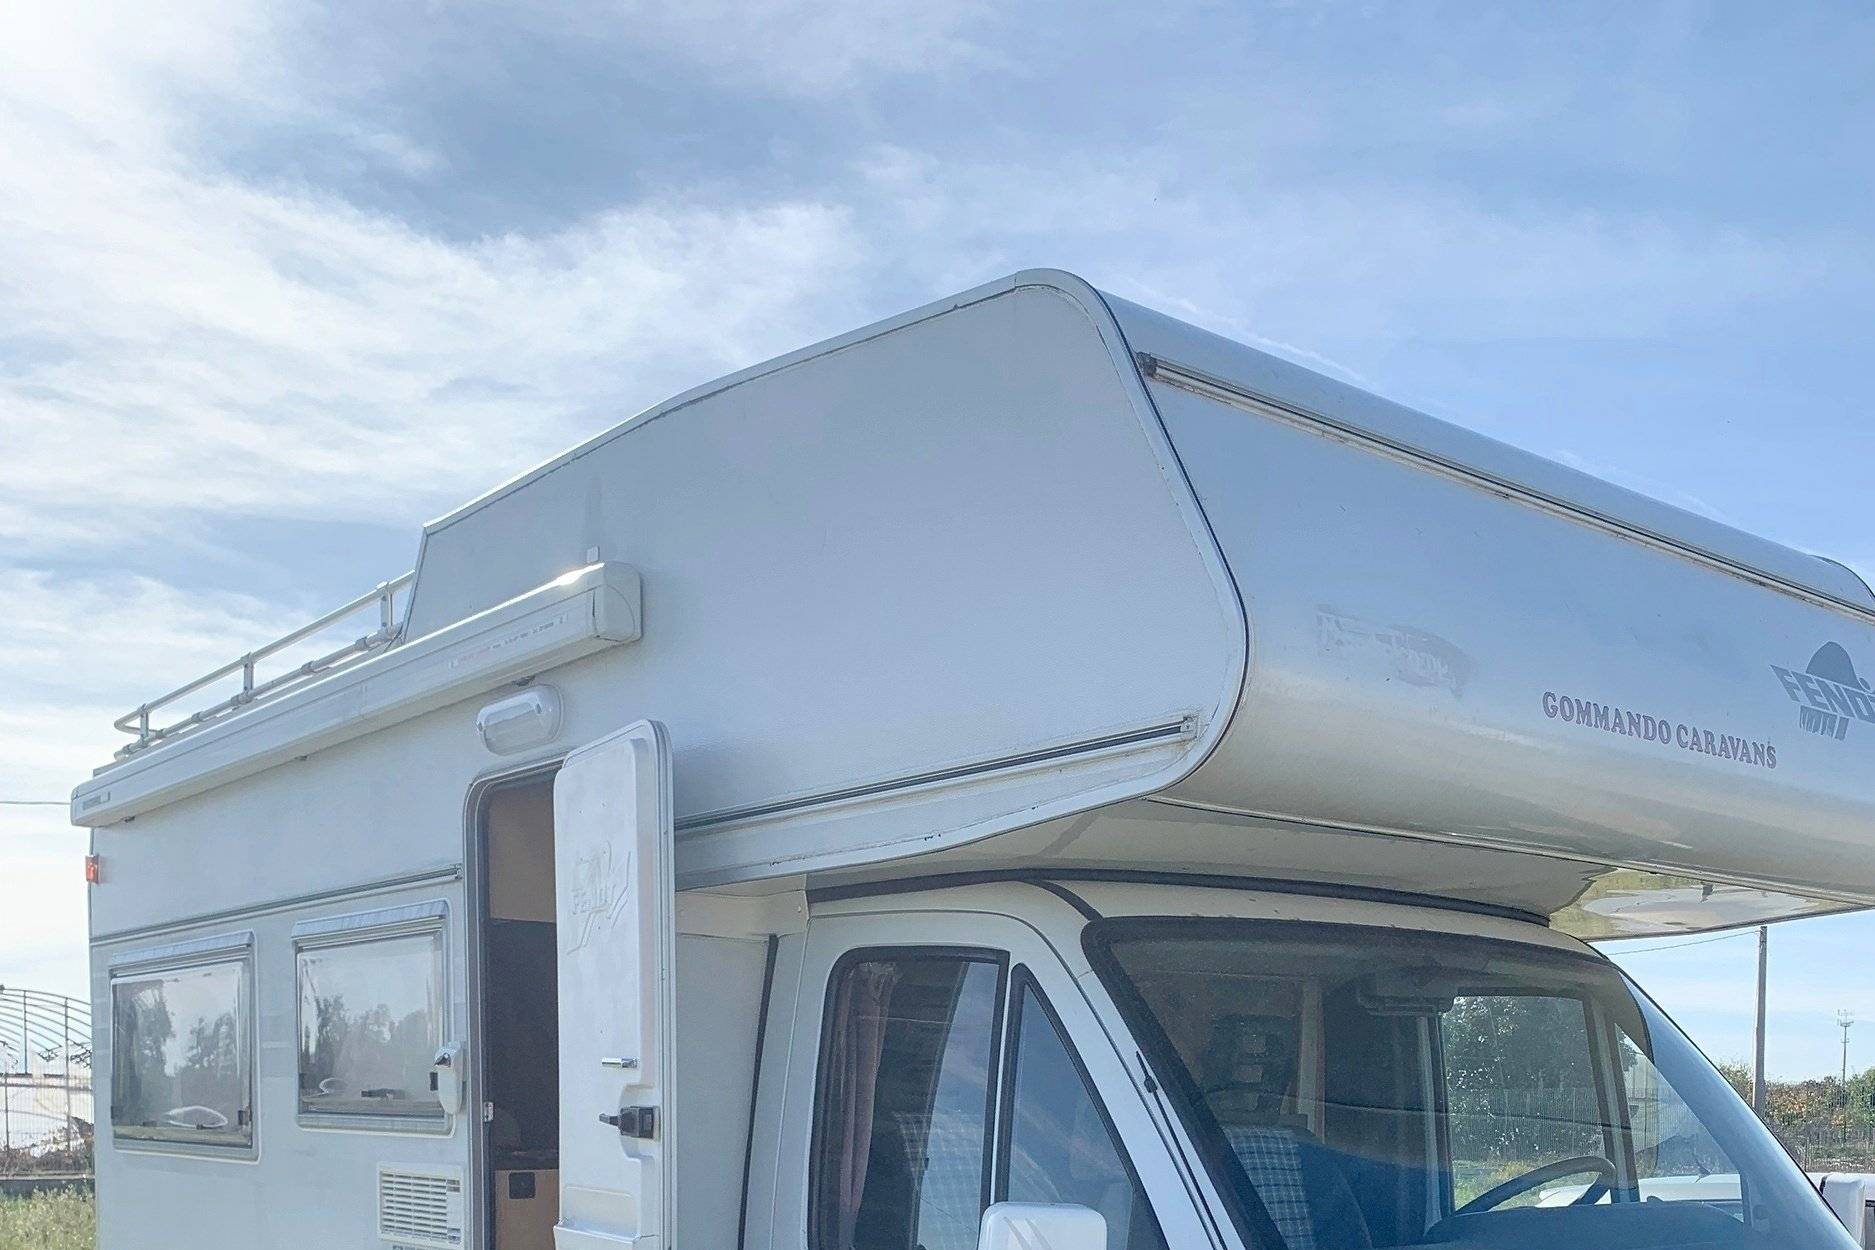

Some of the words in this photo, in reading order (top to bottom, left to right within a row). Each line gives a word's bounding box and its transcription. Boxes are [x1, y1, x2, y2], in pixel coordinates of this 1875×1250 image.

[1769, 665, 1875, 724] FEND
[1542, 691, 1672, 745] GOMMANDO
[1676, 723, 1777, 769] CARAVANS
